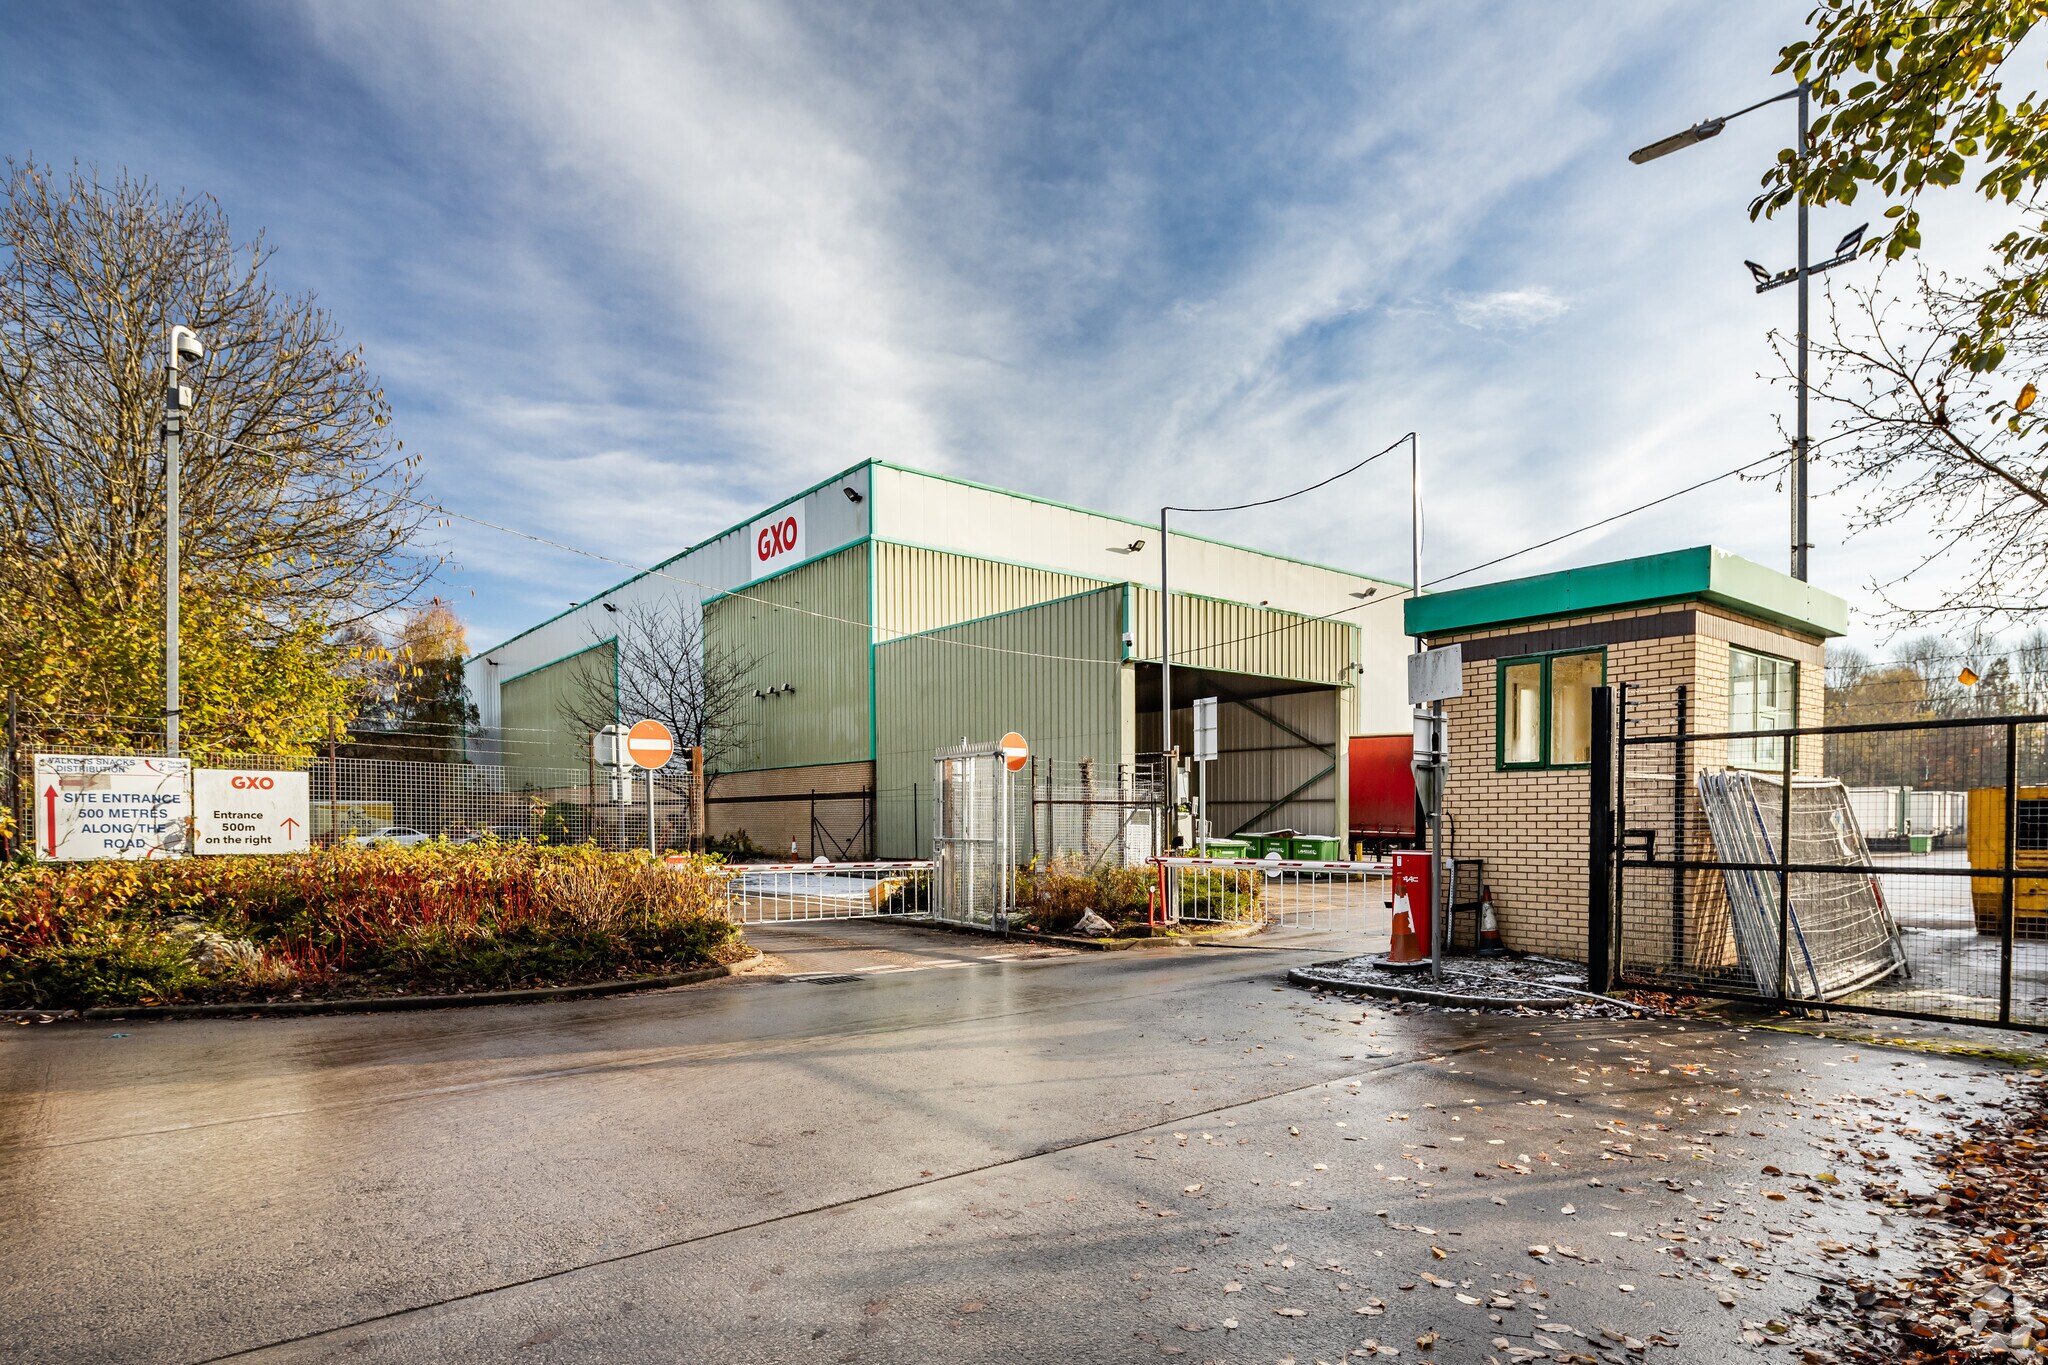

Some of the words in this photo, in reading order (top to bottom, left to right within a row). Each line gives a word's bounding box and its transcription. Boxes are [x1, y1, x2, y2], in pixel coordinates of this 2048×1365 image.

[757, 516, 798, 561] GXO
[96, 758, 136, 766] SNACKS
[56, 765, 125, 774] DISTRIBUTION
[231, 776, 274, 790] GXO
[64, 793, 97, 803] SITE
[102, 793, 181, 804] ENTRANCE
[79, 808, 104, 819] 500
[109, 808, 168, 819] METRES
[213, 810, 263, 819] Entrance
[82, 823, 133, 834] ALONG
[138, 824, 166, 834] THE
[222, 822, 256, 832] 500m
[104, 839, 146, 849] ROAD
[223, 836, 242, 844] the
[245, 835, 272, 846] right
